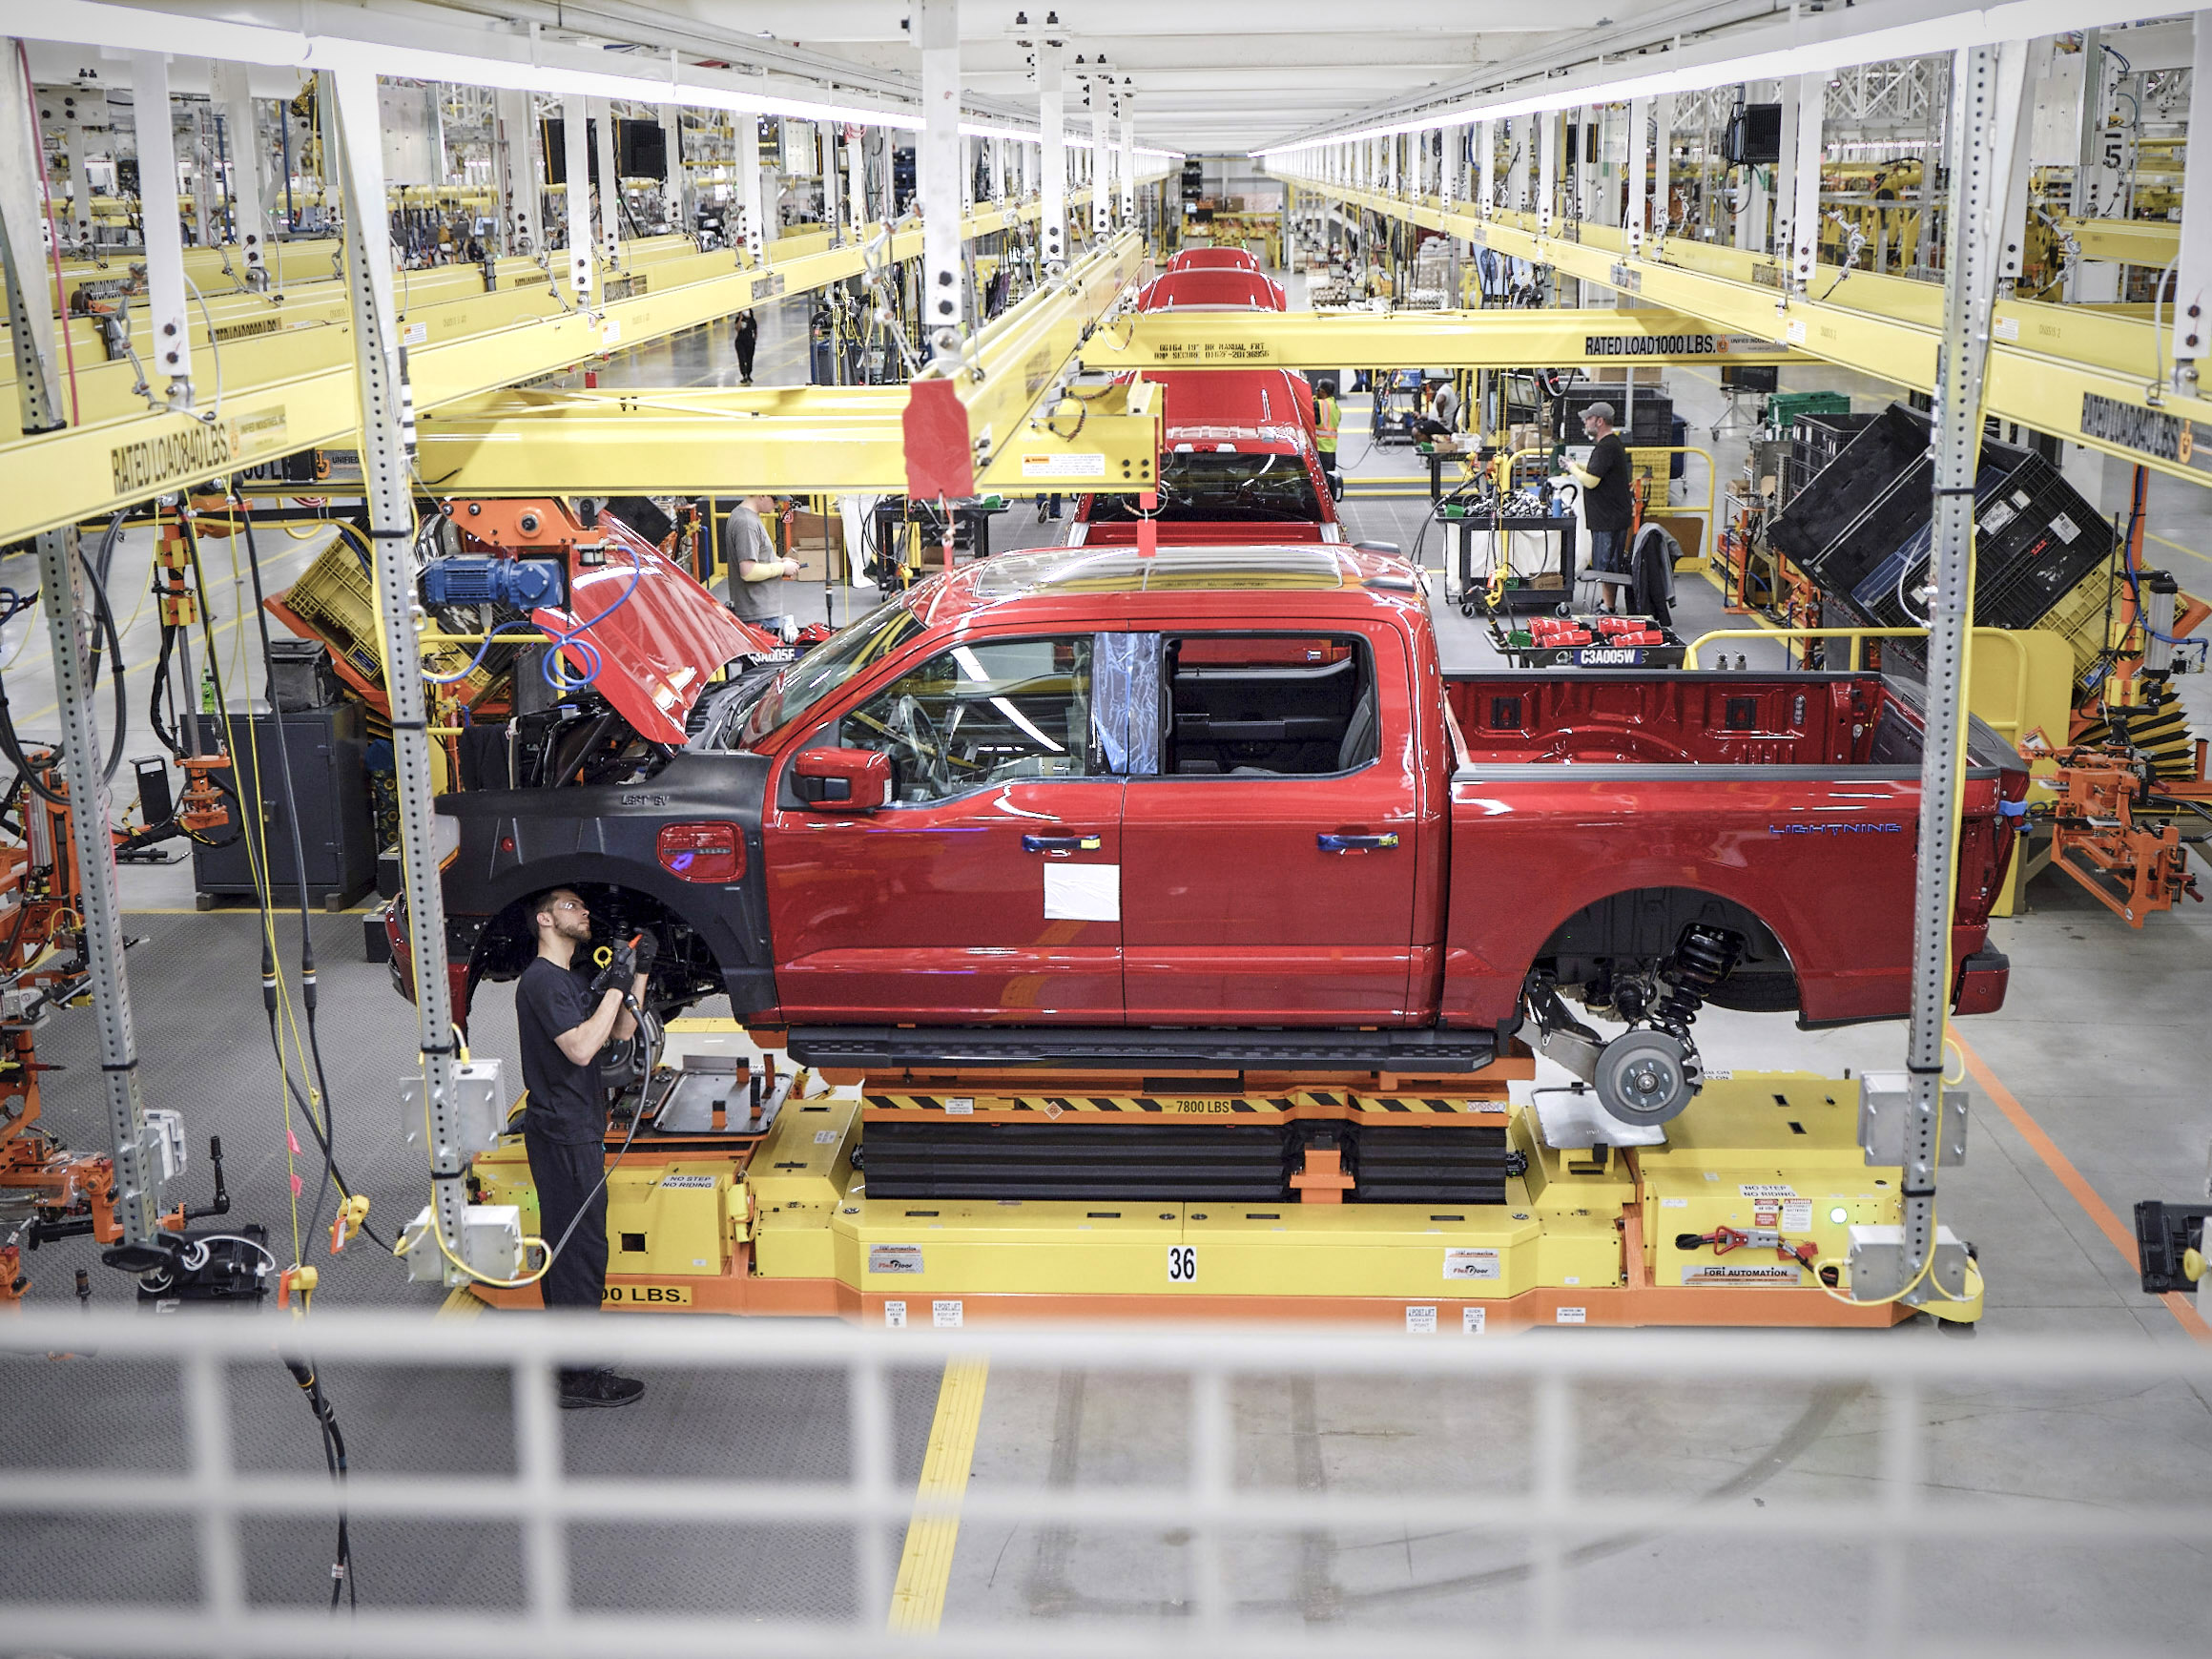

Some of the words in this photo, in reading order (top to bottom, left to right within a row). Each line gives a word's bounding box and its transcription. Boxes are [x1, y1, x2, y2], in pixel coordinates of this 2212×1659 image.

[1585, 336, 1622, 355] RATED
[1685, 334, 1716, 354] LBS.
[111, 442, 151, 495] RATED
[204, 423, 231, 468] LBS.
[1580, 649, 1636, 664] C3A005W
[1768, 822, 1902, 837] LIGHTNING
[1176, 1100, 1205, 1113] 7800
[1208, 1100, 1230, 1113] LBS
[1169, 1247, 1195, 1279] 36
[631, 1288, 688, 1303] LBS.
